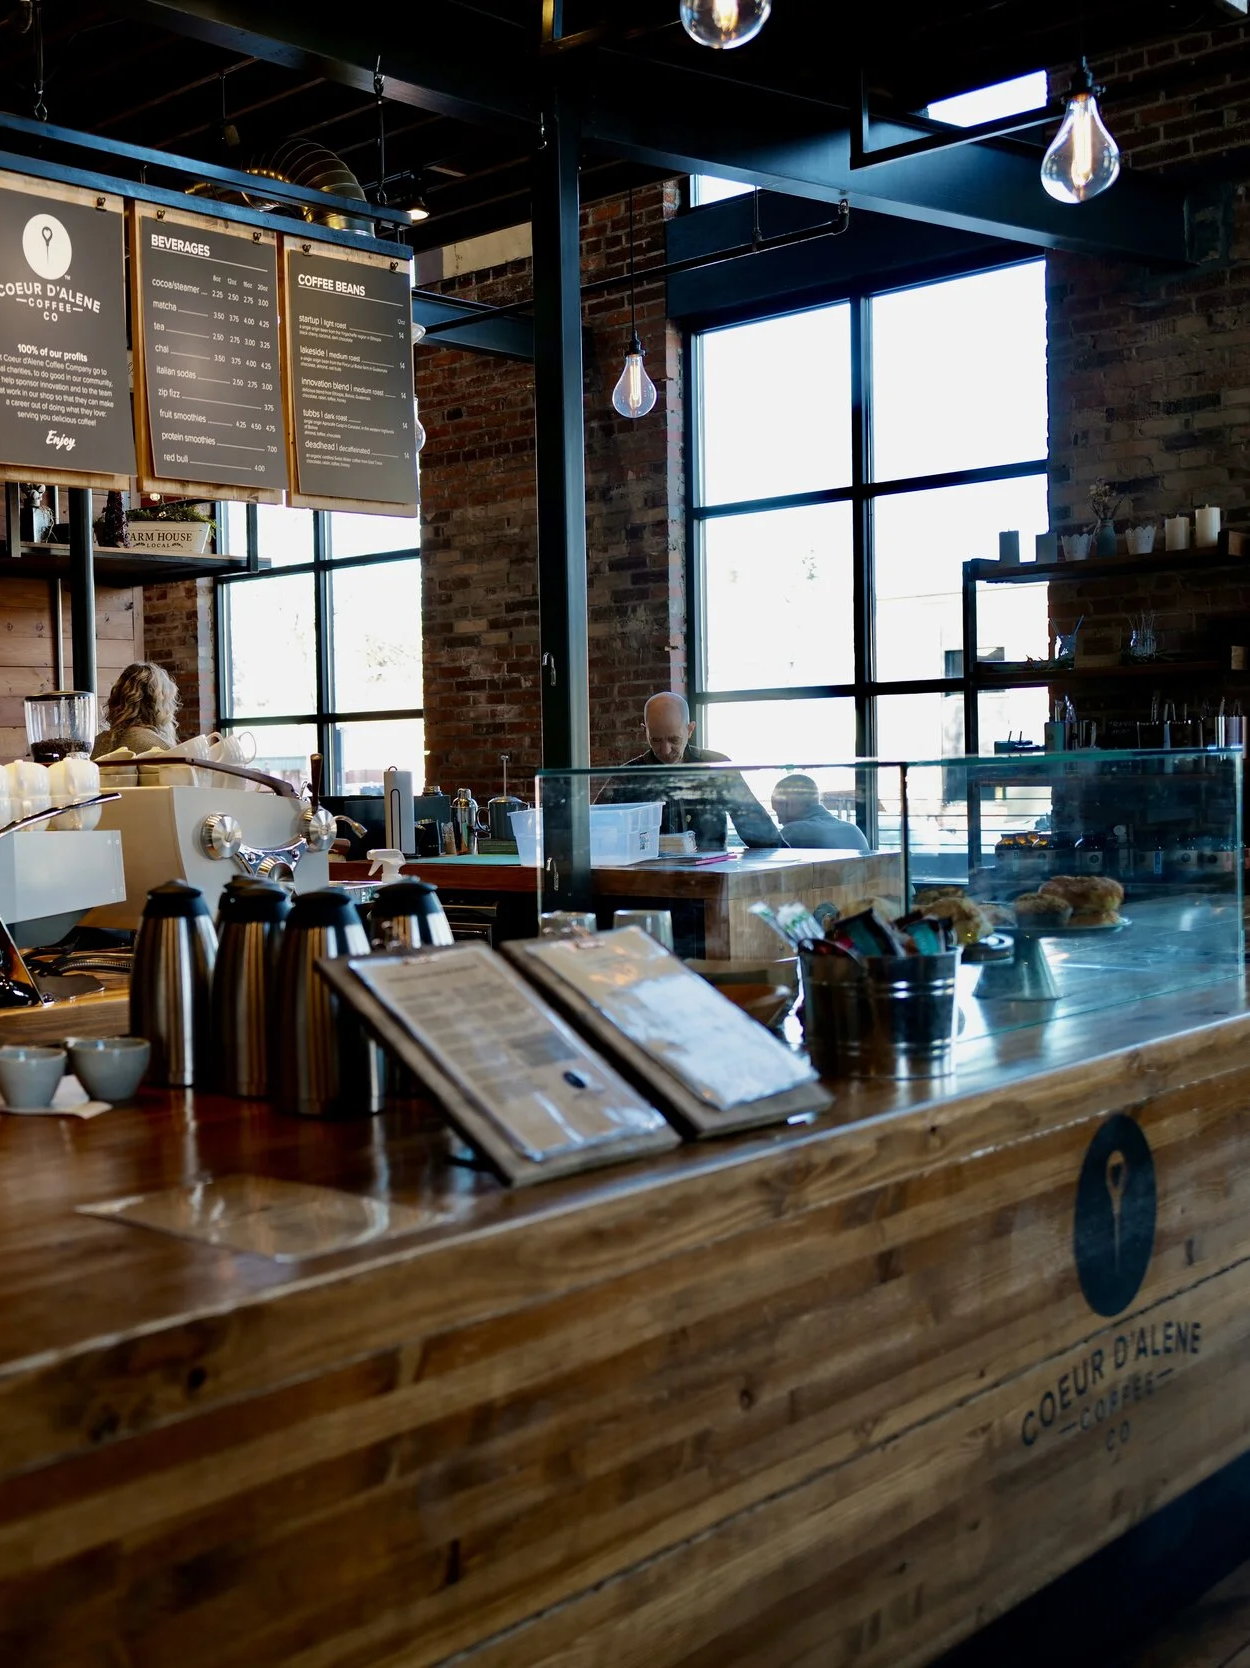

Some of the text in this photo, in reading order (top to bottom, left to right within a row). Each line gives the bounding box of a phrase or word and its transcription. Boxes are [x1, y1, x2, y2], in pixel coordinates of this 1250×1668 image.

[151, 234, 210, 257] BEVERAGES
[298, 274, 365, 296] COFFEE BEANS
[47, 284, 101, 313] D'ALENE
[152, 278, 269, 307] cocoa/steamer 2.25 2.50 2.75 3.00
[28, 298, 71, 312] COFFEE
[153, 301, 177, 311] matcha
[43, 311, 58, 321] CO
[299, 315, 320, 326] startup
[324, 319, 334, 328] light
[154, 322, 165, 331] tea
[17, 344, 88, 362] 100% of our profits
[155, 344, 169, 353] chai
[300, 346, 325, 357] lakeside
[329, 352, 348, 360] medium
[3, 354, 22, 363] Coeur
[22, 357, 44, 366] d'Alene
[45, 359, 64, 369] Coffee
[65, 362, 92, 375] Company
[92, 368, 100, 376] go
[101, 368, 107, 376] to
[156, 365, 197, 379] italian sodas
[33, 369, 40, 377] to
[41, 370, 49, 378] do
[49, 372, 65, 380] good
[66, 373, 71, 381] in
[1, 376, 15, 385] help
[15, 378, 39, 387] sponsor
[40, 381, 69, 391] innovation
[88, 387, 98, 395] the
[98, 389, 112, 397] team
[301, 377, 332, 388] innovation
[333, 382, 349, 391] blend
[158, 388, 274, 412] zip fizz 3.75
[11, 399, 30, 408] career
[41, 402, 48, 410] of
[49, 403, 65, 414] doing
[66, 406, 80, 414] what
[80, 407, 93, 417] they
[303, 409, 320, 418] tubbs
[324, 412, 335, 420] dark
[17, 411, 39, 421] serving
[52, 414, 77, 424] delicious
[159, 409, 206, 423] fruit smoothies
[46, 430, 76, 451] Enjoy
[161, 432, 278, 453] protein smoothies 7.00
[305, 440, 335, 451] deadhead
[339, 445, 370, 455] decaffeinated
[163, 453, 175, 462] red
[176, 454, 188, 463] bull
[157, 532, 192, 541] HOUSE
[1022, 1322, 1201, 1446] COEUR D'ALENE
[1080, 1371, 1153, 1431] COFFEE
